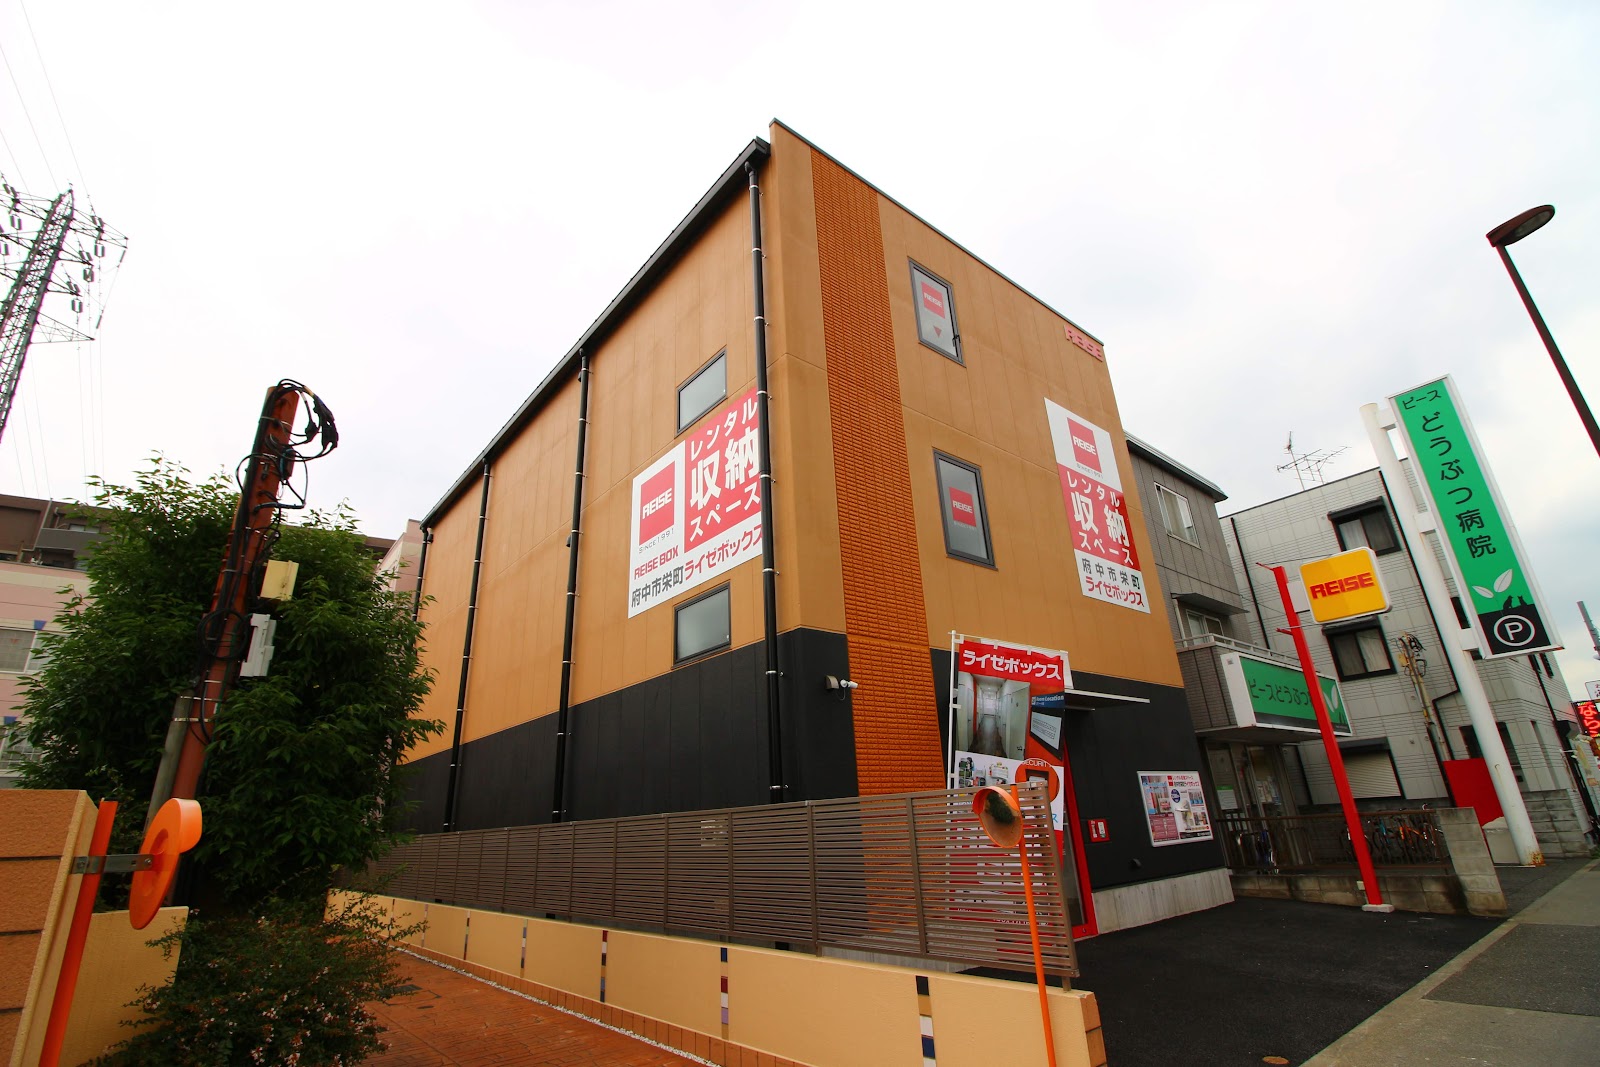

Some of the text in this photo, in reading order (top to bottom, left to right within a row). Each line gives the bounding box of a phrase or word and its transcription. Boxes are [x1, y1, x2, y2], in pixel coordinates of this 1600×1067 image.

[690, 397, 758, 462] レンタル
[1072, 435, 1097, 456] REISE
[689, 425, 761, 511] 収納
[1066, 470, 1120, 508] レンタル
[1421, 411, 1497, 559] どうぶつ病院
[642, 487, 673, 520] REISE
[689, 481, 761, 543] スペース
[952, 500, 973, 514] REISE
[1070, 491, 1130, 548] 収納
[633, 544, 679, 581] REISE BOX
[1079, 531, 1134, 566] スペース
[1082, 558, 1141, 590] 府中市栄町
[1309, 571, 1375, 600] REISE
[1085, 575, 1145, 608] ライゼボックス
[1503, 621, 1524, 641] P
[962, 649, 1062, 681] ライゼボックス
[1247, 678, 1310, 706] ピースどうぶつ
